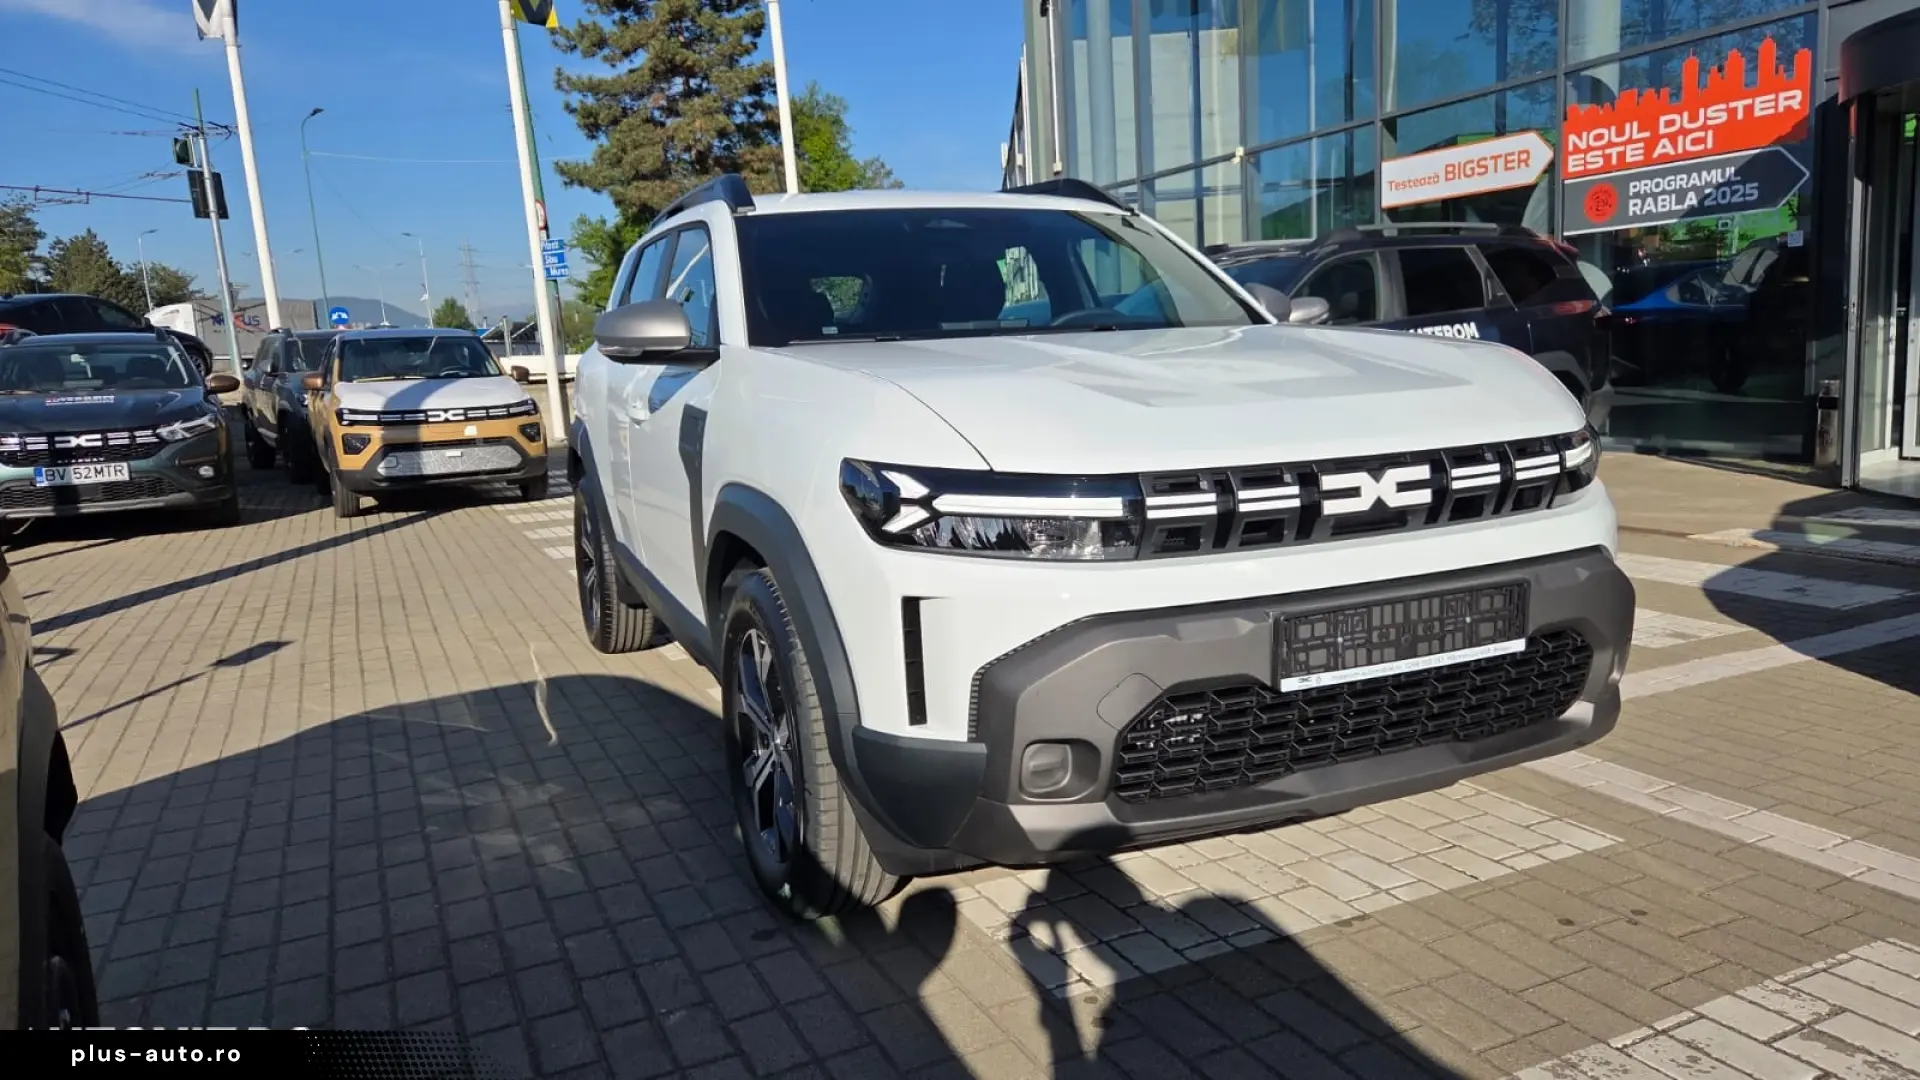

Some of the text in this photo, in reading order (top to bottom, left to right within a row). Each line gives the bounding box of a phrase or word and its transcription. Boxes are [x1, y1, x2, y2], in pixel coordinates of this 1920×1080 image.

[1567, 89, 1803, 152] NOUL DUSTER
[1444, 149, 1531, 182] BIGSTER
[1567, 130, 1714, 173] ESTE AICI
[1628, 166, 1742, 196] PROGRAMUL
[1628, 190, 1699, 217] RABLA
[1704, 182, 1760, 206] 2025
[1409, 321, 1480, 340] TEROM
[45, 468, 66, 482] BV
